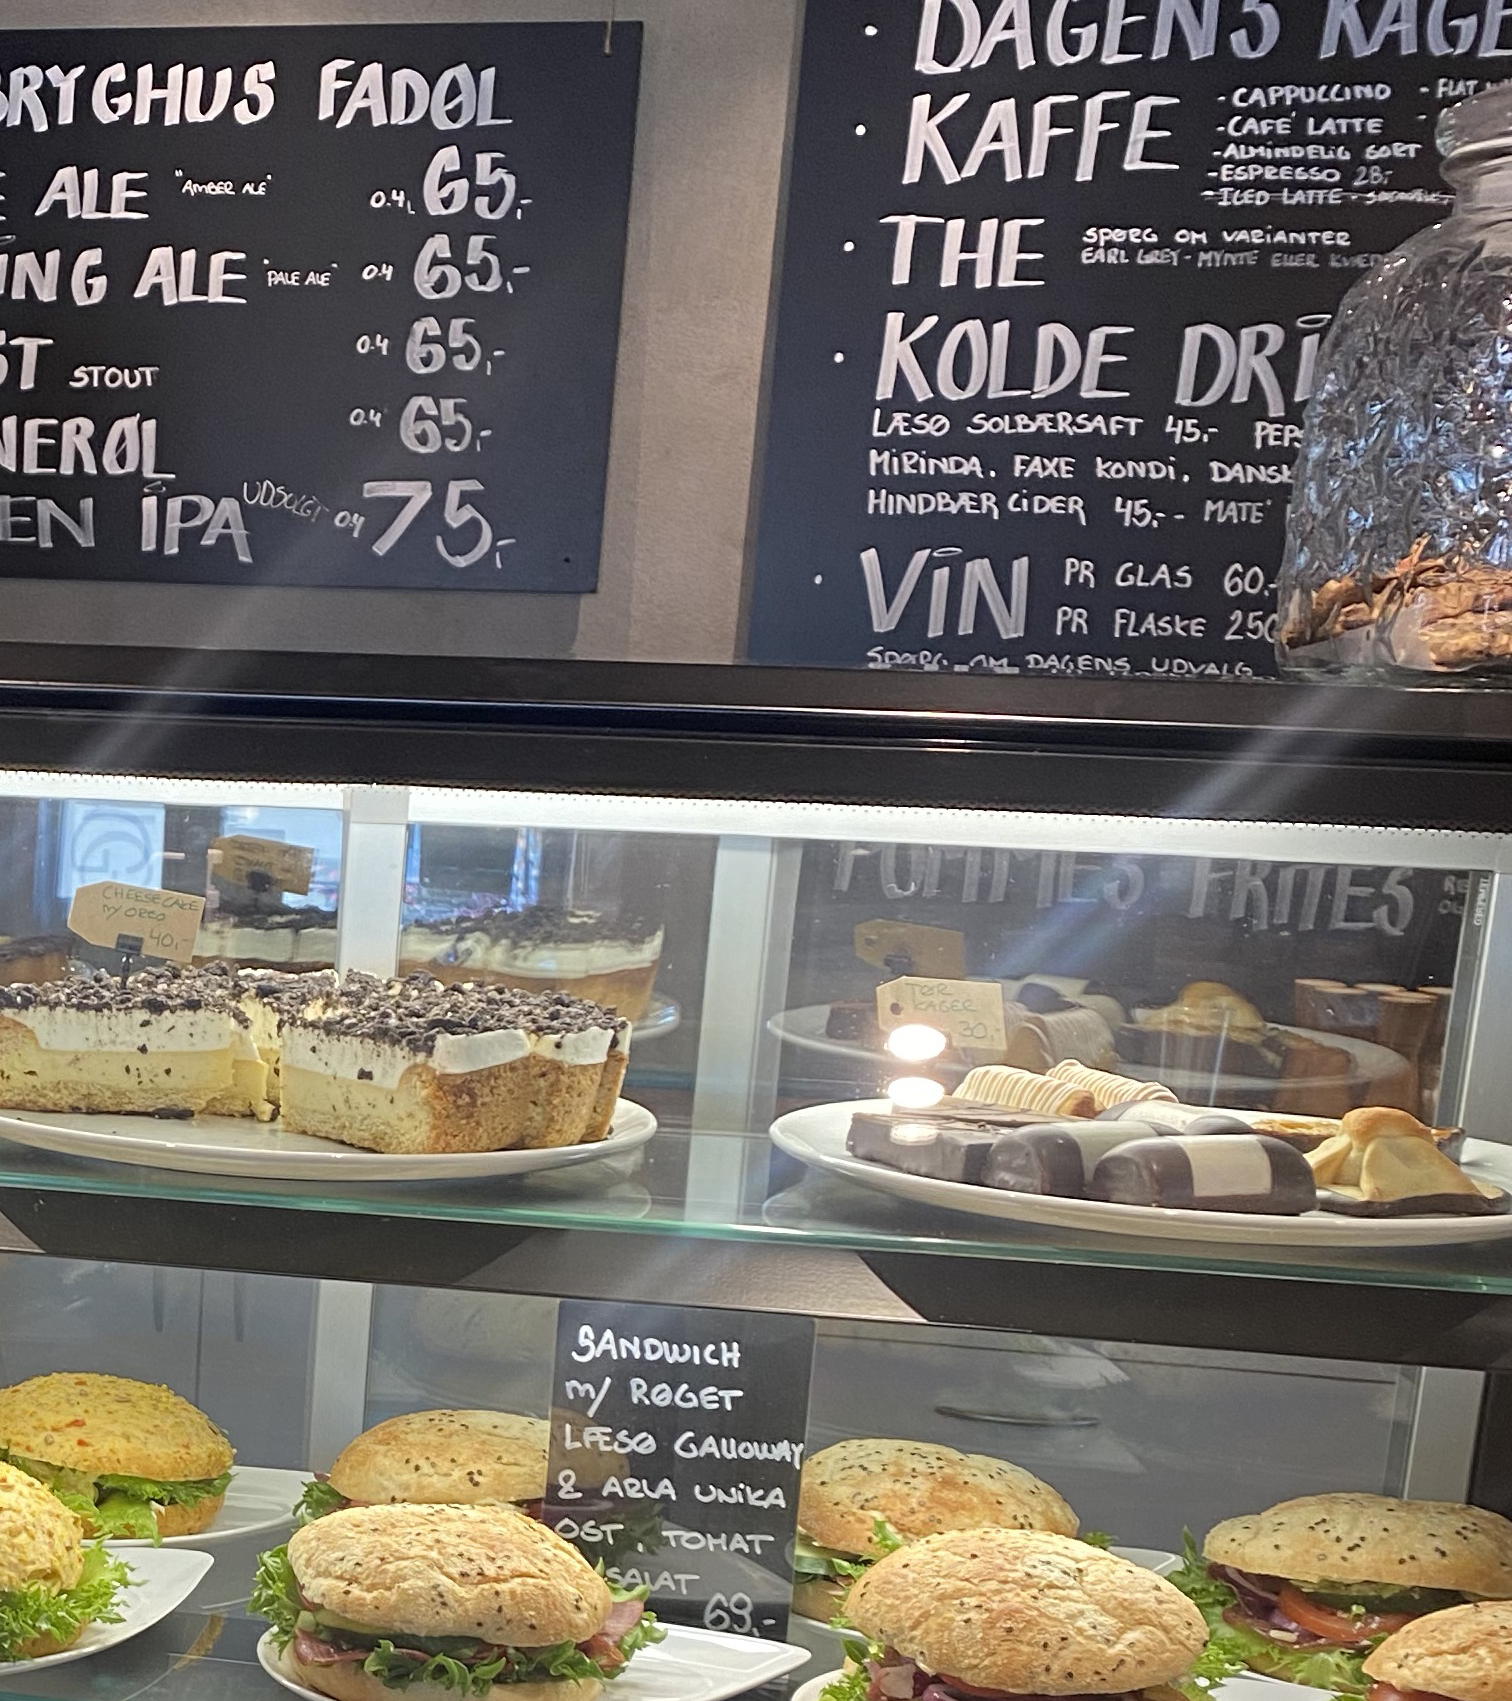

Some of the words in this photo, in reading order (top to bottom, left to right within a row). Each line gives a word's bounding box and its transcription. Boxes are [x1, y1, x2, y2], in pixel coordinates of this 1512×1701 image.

[915, 0, 1280, 74] DAGENS
[318, 58, 513, 130] FADØL
[901, 90, 1180, 185] KAFFE
[1307, 117, 1384, 136] LATTE
[1365, 143, 1422, 160] SORT
[35, 165, 148, 220] ALE
[1282, 187, 1343, 205] LATTE
[879, 213, 1046, 289] THE
[1082, 227, 1159, 245] SPØRG
[1175, 229, 1208, 245] OM
[1081, 246, 1129, 265] EARL
[1137, 248, 1181, 267] GREY
[1197, 250, 1258, 269] MYNTE
[1270, 252, 1320, 269] ELLER
[134, 246, 247, 306] ALE
[875, 311, 1135, 402] KOLDE
[69, 365, 159, 389] STOUT
[872, 407, 950, 438] LÆSØ
[966, 411, 1144, 437] SOLBÆRSAFT
[1013, 454, 1076, 480] FAXE
[243, 480, 329, 522] UDSOLGT
[867, 489, 999, 520] HINDBÆR
[1064, 557, 1095, 588] PR
[1115, 561, 1193, 590] GLAS
[1055, 605, 1088, 638] PR
[1114, 608, 1207, 640] FLASKE
[1151, 657, 1254, 676] UDVALG
[905, 982, 953, 997] TØR
[913, 999, 977, 1013] KAGER
[571, 1324, 741, 1369] SANDWICH
[629, 1377, 744, 1411] RØGET
[564, 1423, 657, 1454] LÆSØ
[674, 1430, 805, 1470] GALLOWAY
[557, 1469, 583, 1499] &
[601, 1476, 676, 1501] ARLA
[661, 1529, 775, 1555] TOMAT
[605, 1566, 700, 1596] SALAT
